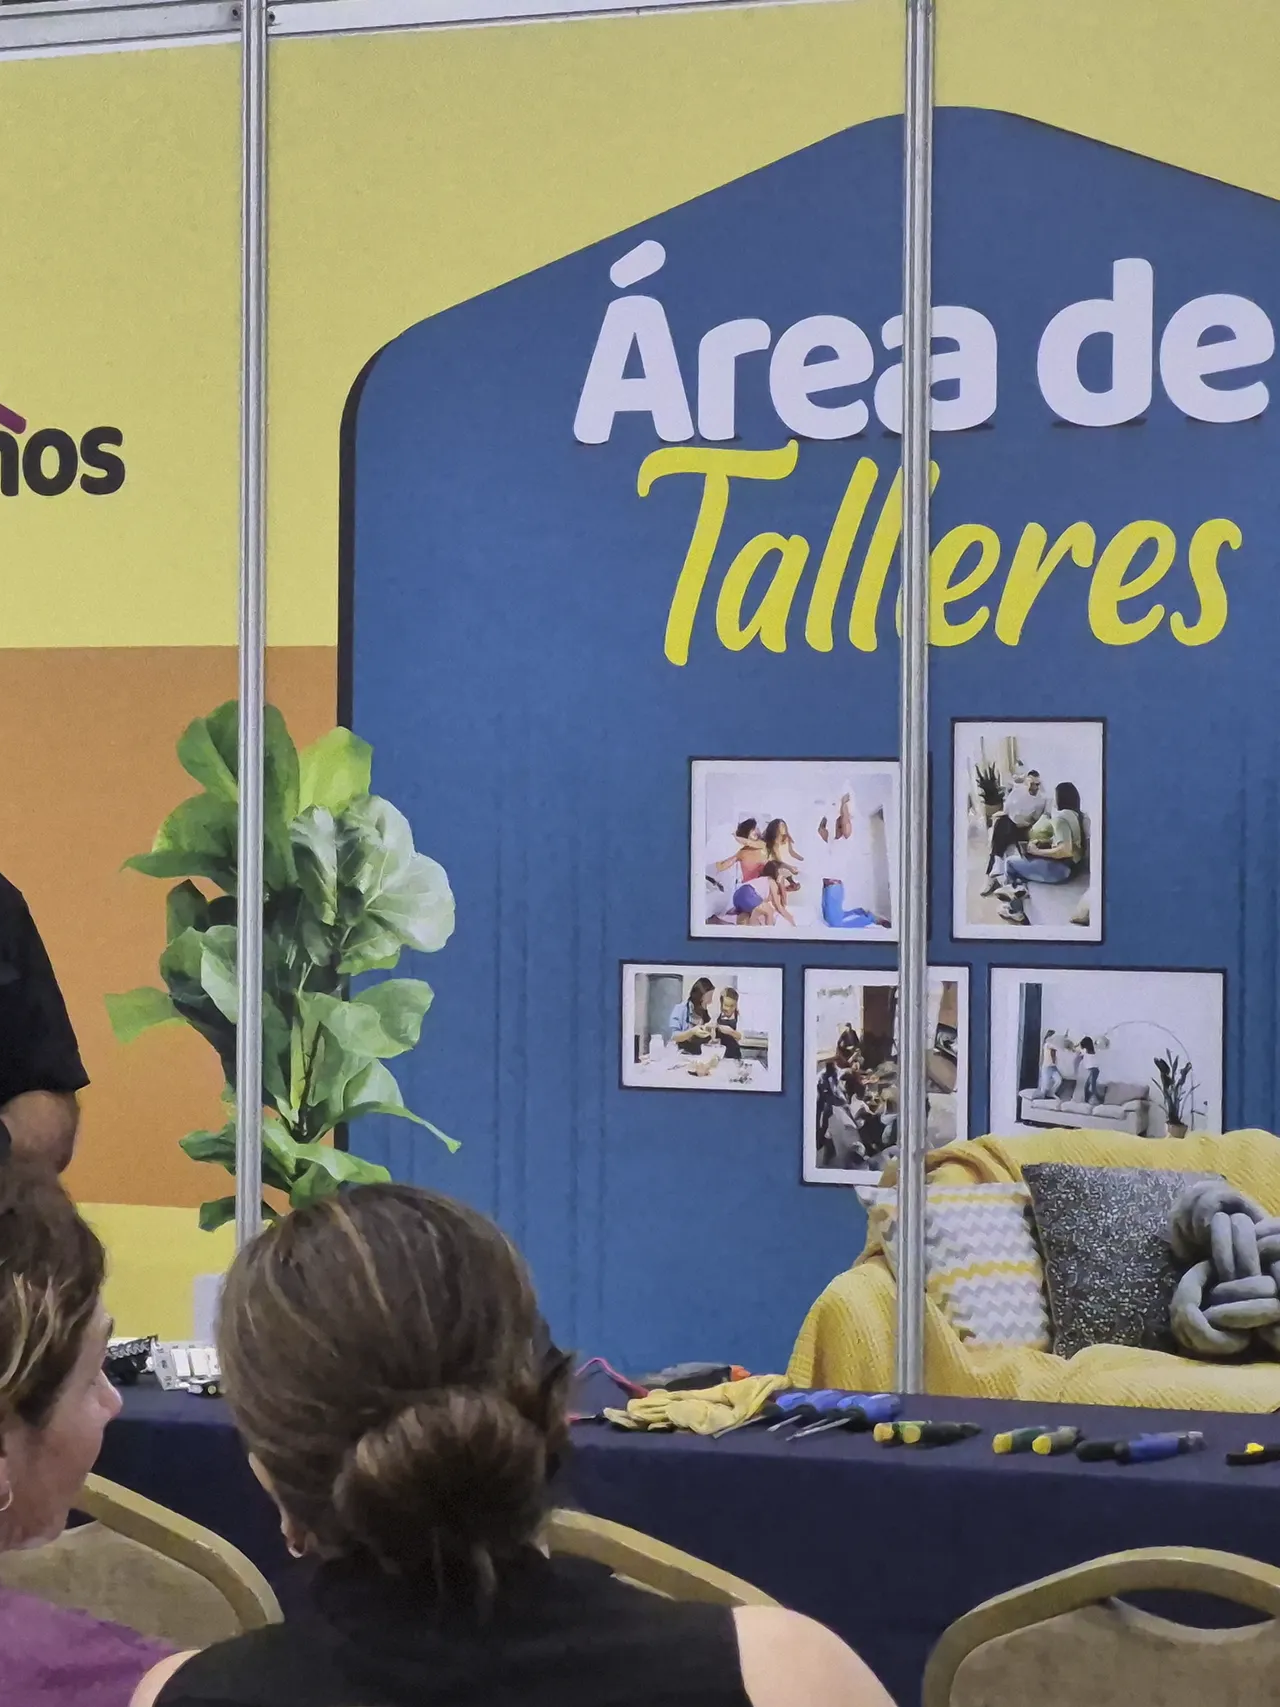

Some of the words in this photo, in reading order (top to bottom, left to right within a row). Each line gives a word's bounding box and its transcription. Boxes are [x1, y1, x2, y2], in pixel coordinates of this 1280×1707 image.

[572, 239, 998, 444] Área
[1037, 257, 1276, 428] de
[636, 439, 1243, 666] Talleres
